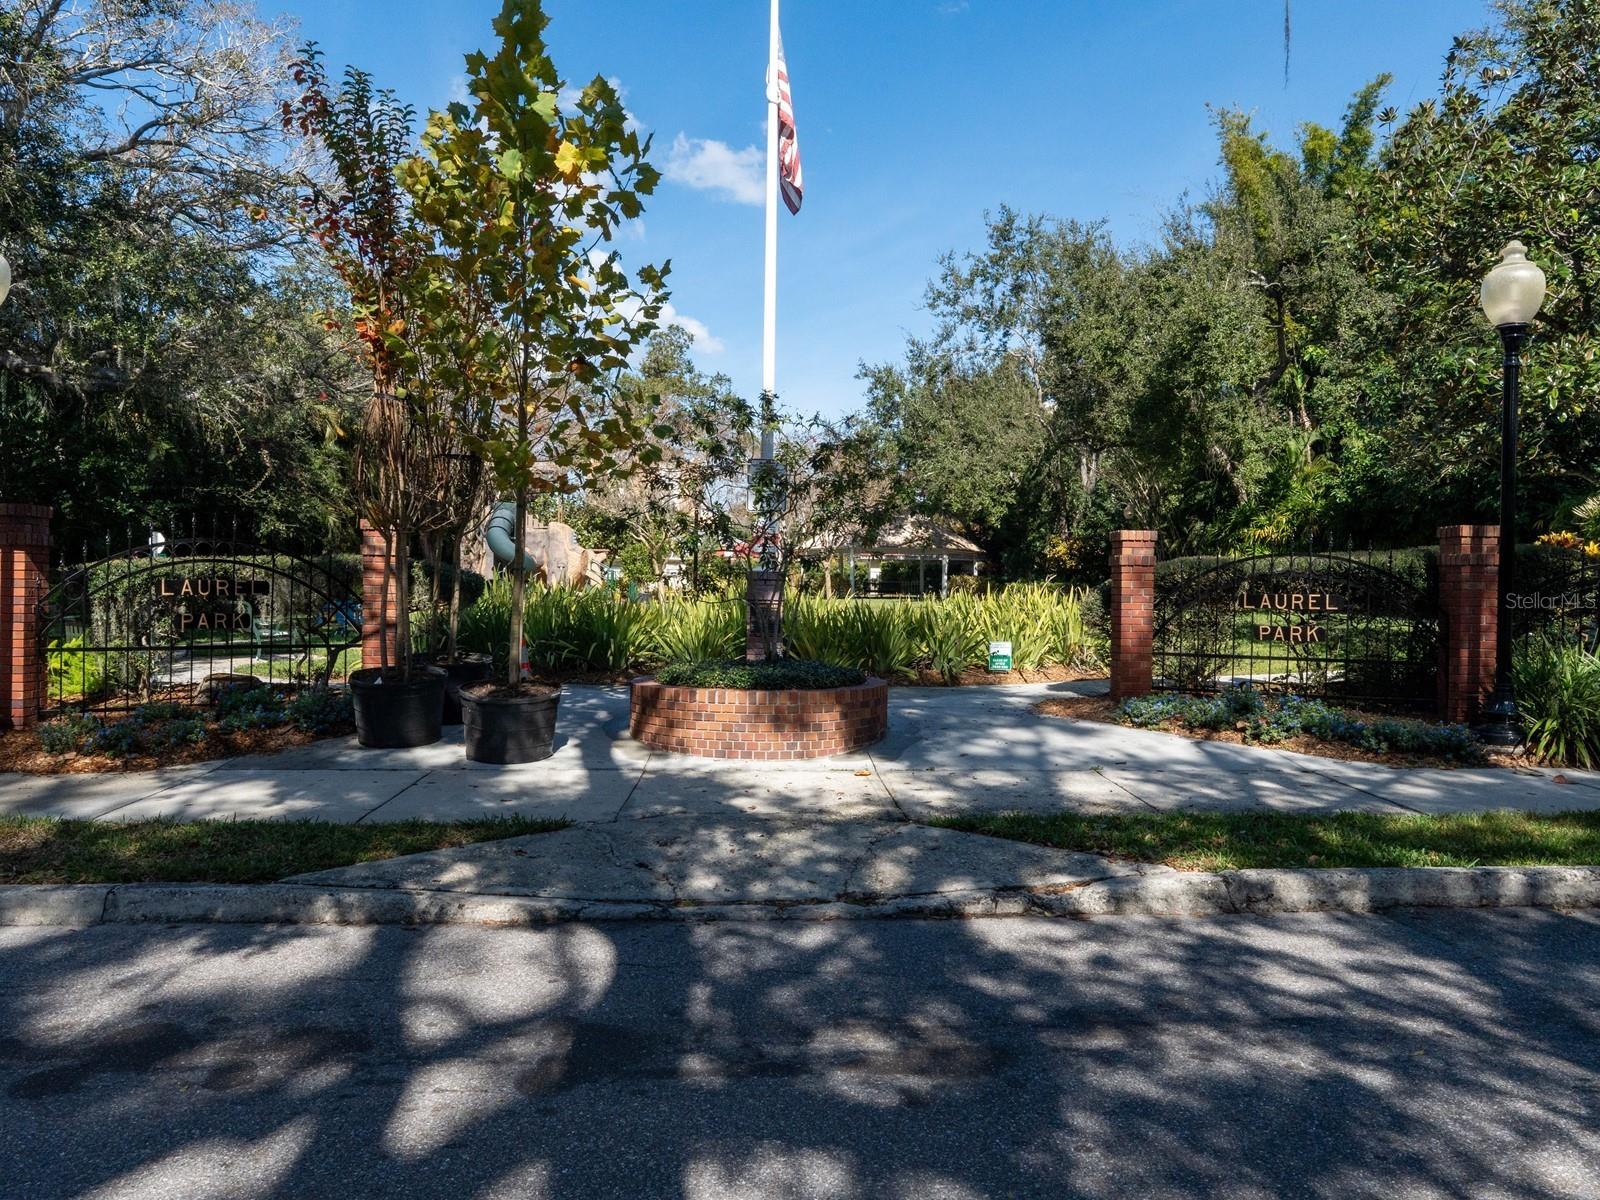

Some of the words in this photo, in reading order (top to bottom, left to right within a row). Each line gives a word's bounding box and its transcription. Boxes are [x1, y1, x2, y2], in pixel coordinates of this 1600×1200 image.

[160, 578, 260, 596] LAUREL
[1243, 593, 1338, 610] LAUREL
[180, 612, 247, 632] PARK
[1259, 625, 1319, 642] PARK
